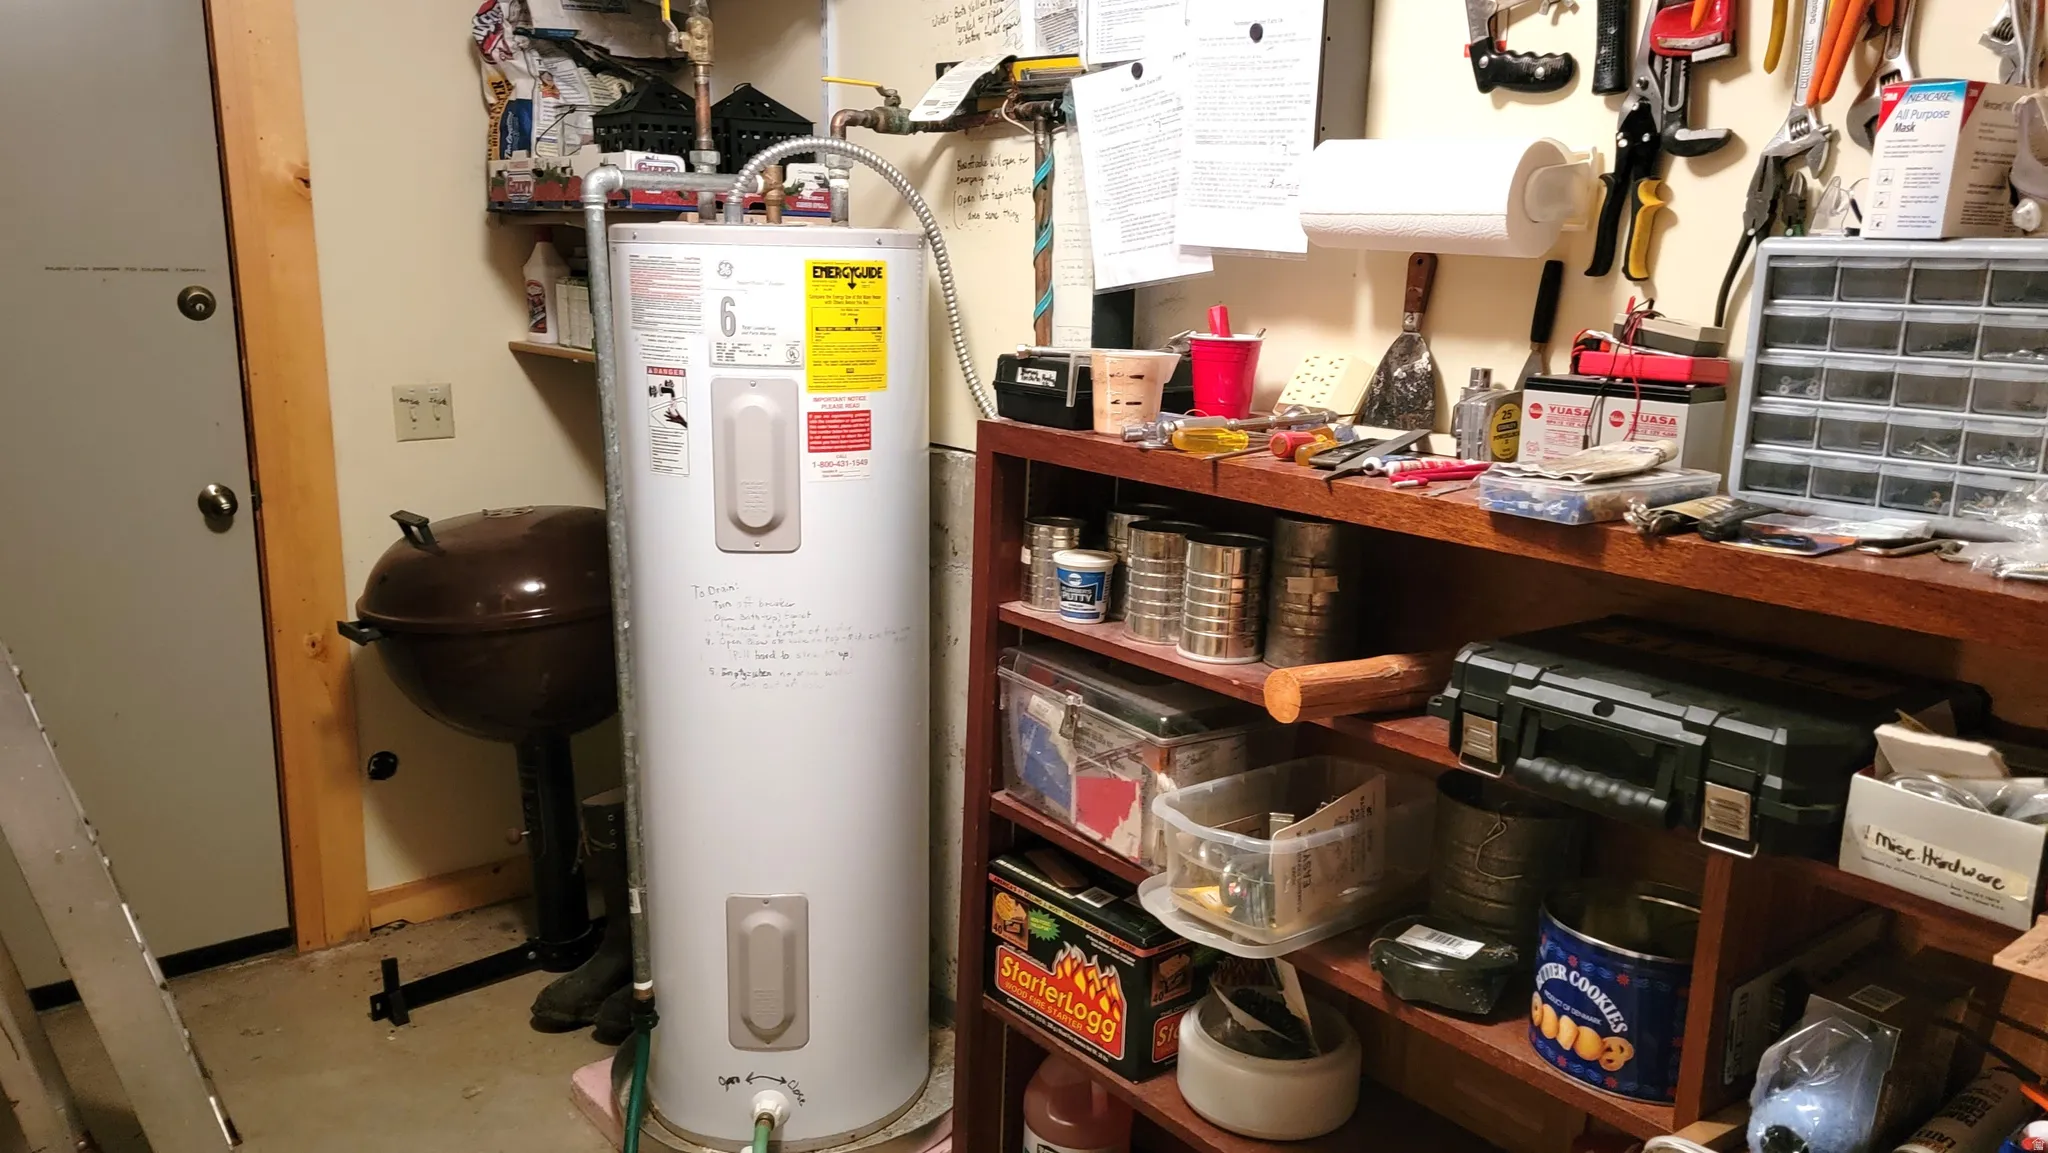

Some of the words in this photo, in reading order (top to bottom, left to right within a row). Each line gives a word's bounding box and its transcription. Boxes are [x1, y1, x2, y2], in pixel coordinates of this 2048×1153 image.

[1906, 92, 1953, 103] NEXCARE
[1895, 109, 1908, 120] All
[1910, 109, 1950, 121] Purpose
[1893, 122, 1916, 133] Mask
[720, 296, 736, 337] 6
[653, 367, 684, 376] DANGER
[1549, 405, 1590, 417] YUASA
[812, 458, 869, 469] 1-800-431-1549
[691, 584, 705, 599] To
[1062, 591, 1092, 602] PUTTY
[1921, 845, 2006, 891] Hardware
[993, 923, 1003, 934] 40
[1001, 956, 1117, 1043] StarterLogg
[1569, 970, 1629, 1034] COOKIES
[1004, 981, 1028, 998] WOOD
[1029, 995, 1046, 1011] FIRE
[1047, 1005, 1083, 1032] STARTER
